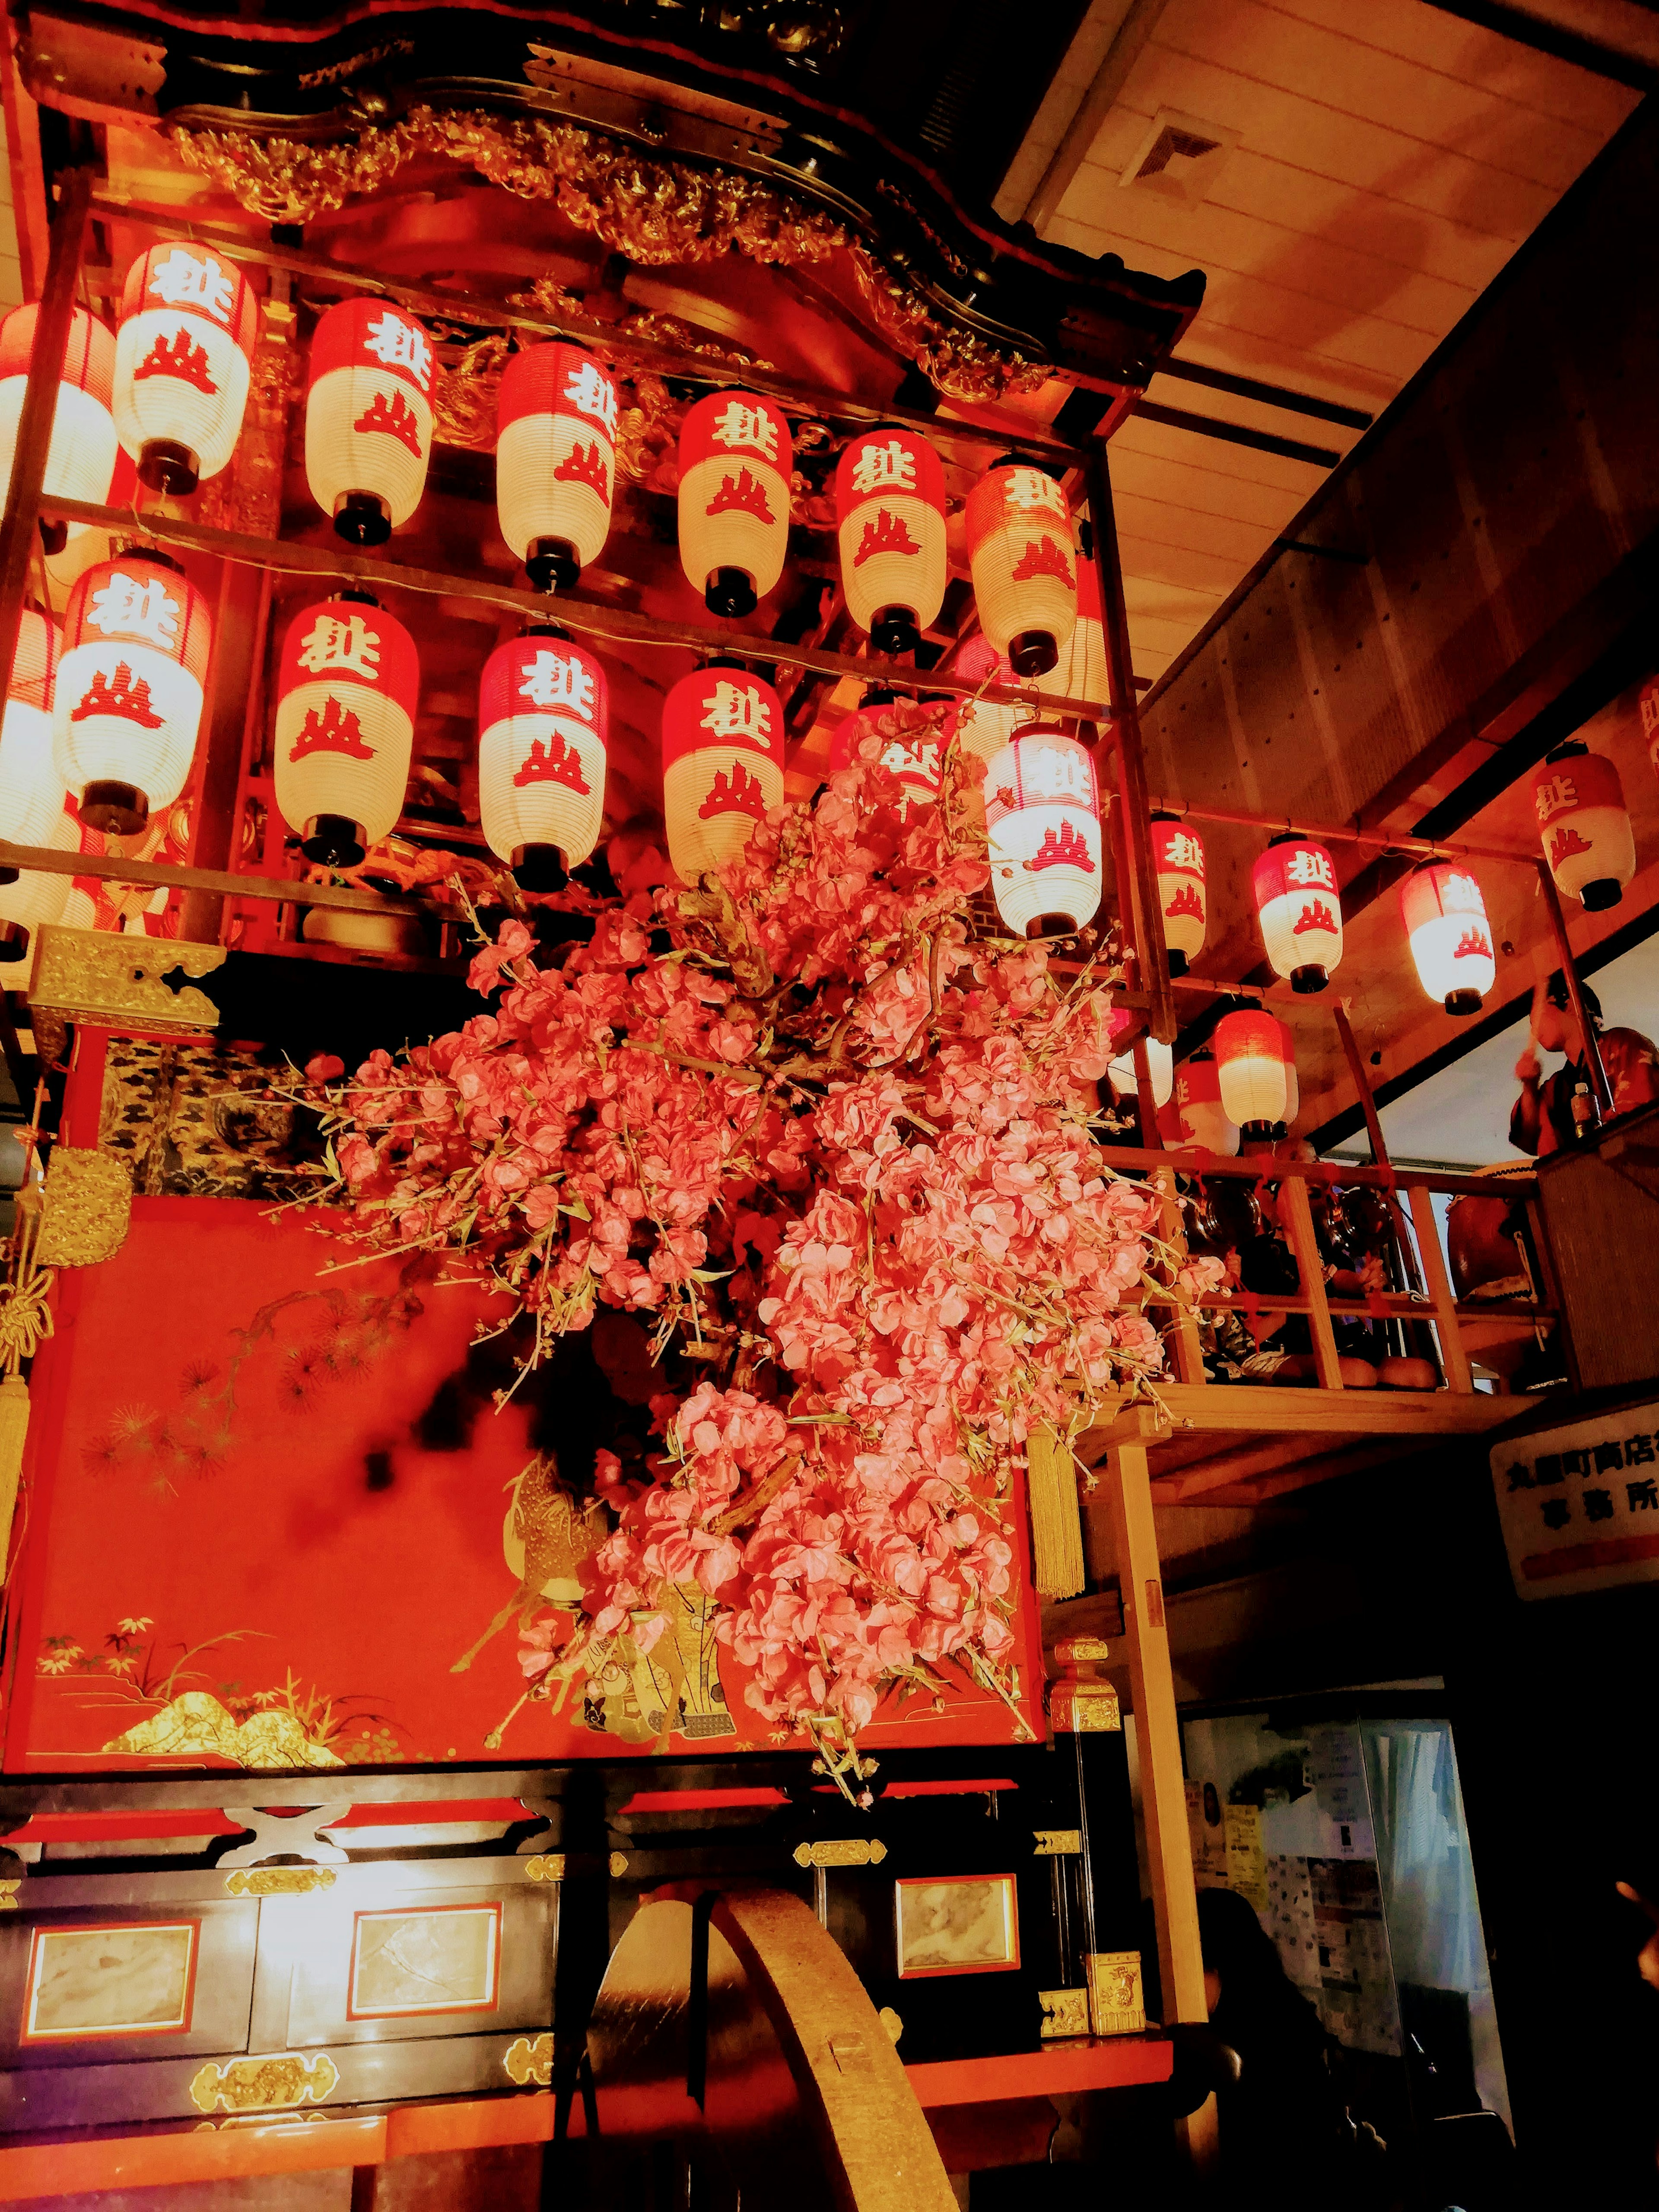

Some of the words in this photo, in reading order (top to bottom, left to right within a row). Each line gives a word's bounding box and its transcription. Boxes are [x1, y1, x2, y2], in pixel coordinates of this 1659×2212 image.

[1507, 1430, 1659, 1492] 丸屋町商店
